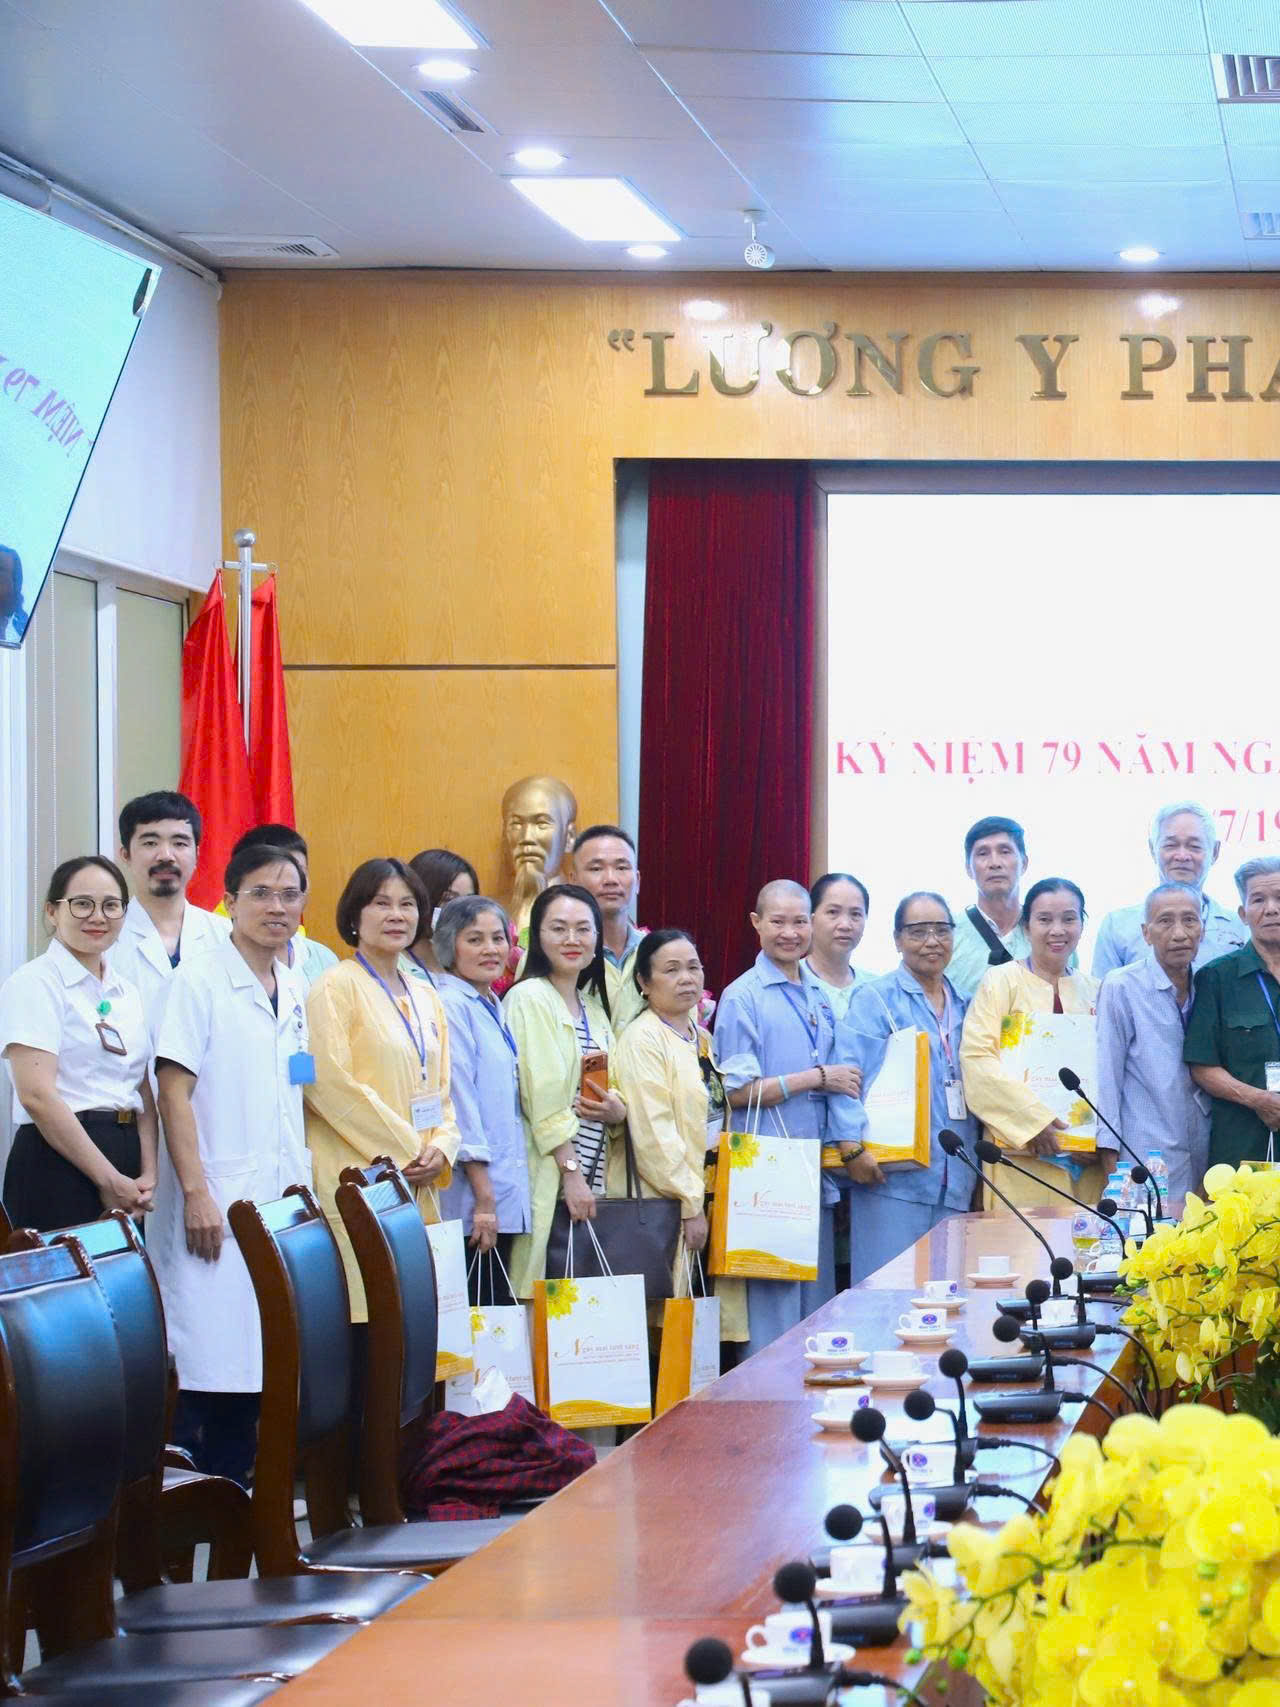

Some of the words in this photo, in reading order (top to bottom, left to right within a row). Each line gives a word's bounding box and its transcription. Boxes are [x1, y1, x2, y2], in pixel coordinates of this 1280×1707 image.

[1014, 333, 1080, 400] Y
[912, 734, 1026, 785] NIỆM
[1041, 740, 1083, 774] 79
[1097, 732, 1196, 775] NĂM
